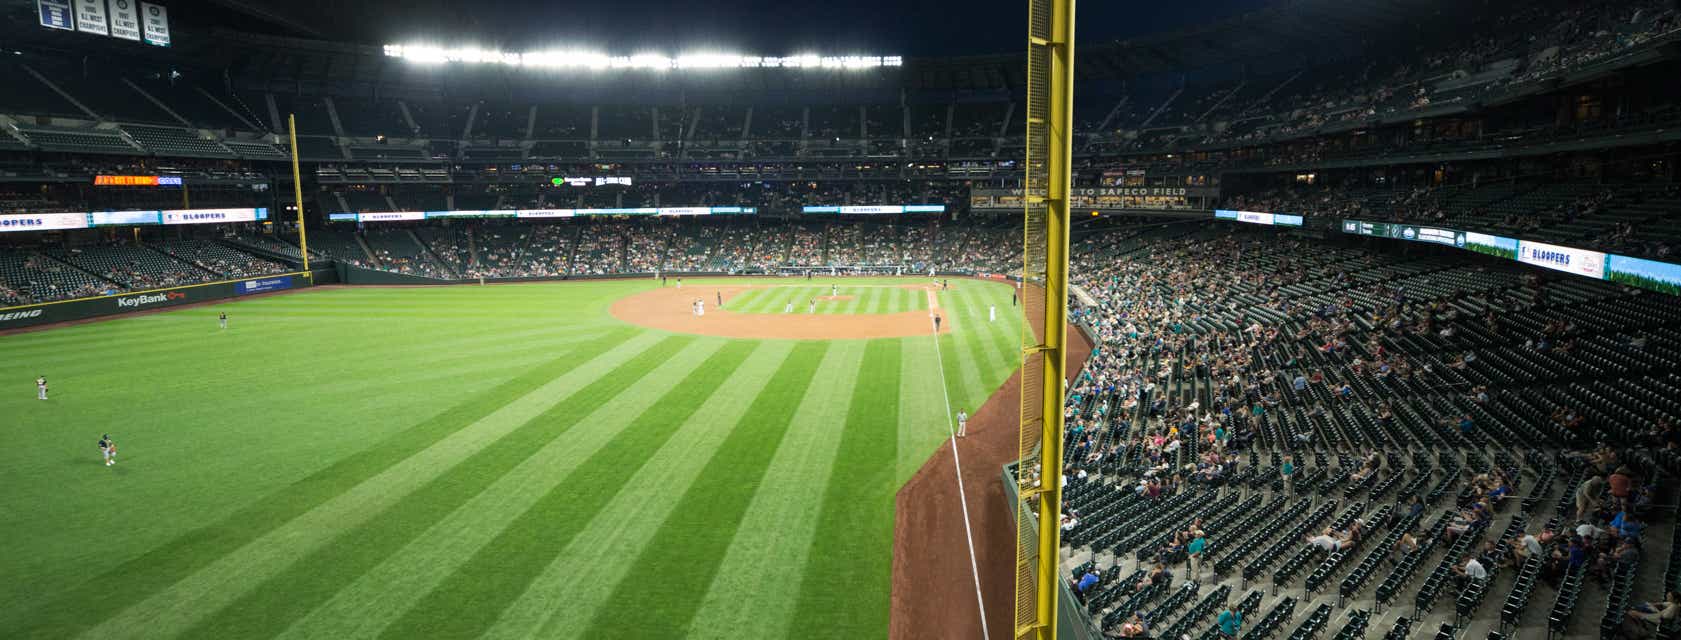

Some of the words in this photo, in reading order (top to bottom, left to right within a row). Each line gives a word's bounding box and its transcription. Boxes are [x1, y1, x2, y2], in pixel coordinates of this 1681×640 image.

[1080, 188, 1095, 196] TO
[1100, 188, 1148, 196] SAFECO
[1153, 188, 1186, 196] FIELD
[183, 212, 226, 220] BLOOPERS
[1532, 248, 1571, 265] BLOOPERS
[118, 293, 168, 307] KeyBank
